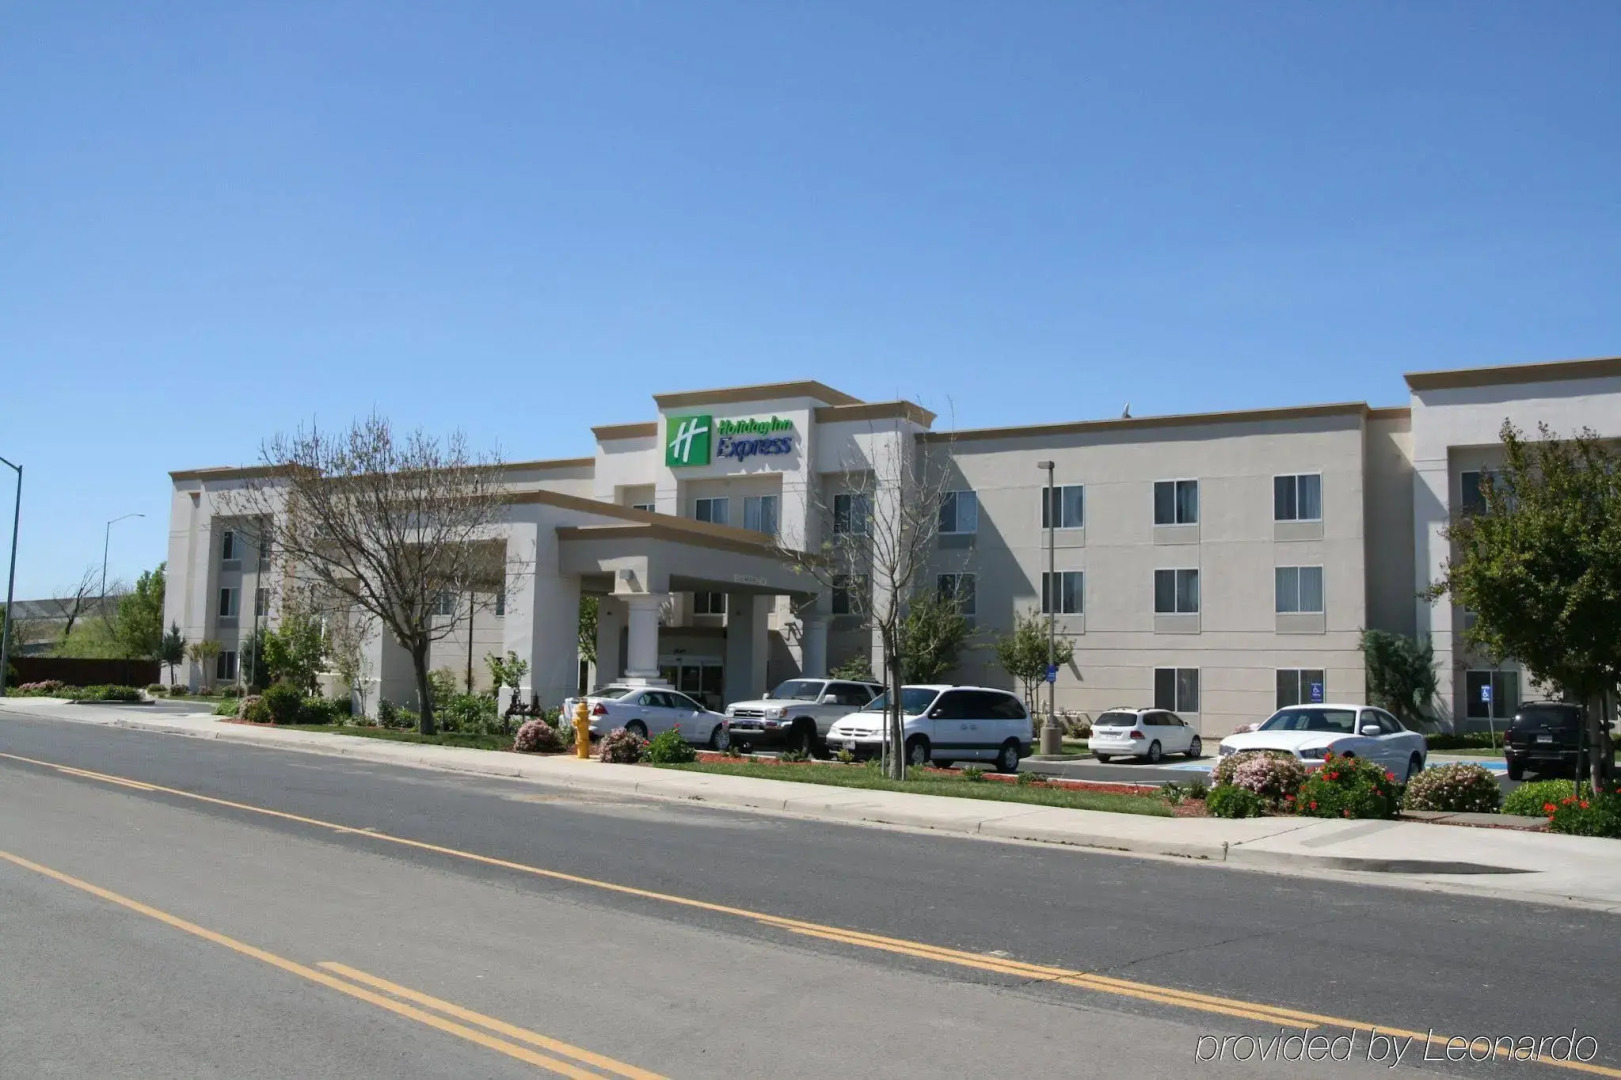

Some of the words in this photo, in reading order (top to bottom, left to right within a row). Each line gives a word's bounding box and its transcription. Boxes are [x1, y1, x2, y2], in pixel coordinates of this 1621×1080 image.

[718, 418, 770, 436] Holiday
[771, 415, 793, 432] Inn
[717, 437, 793, 462] Express
